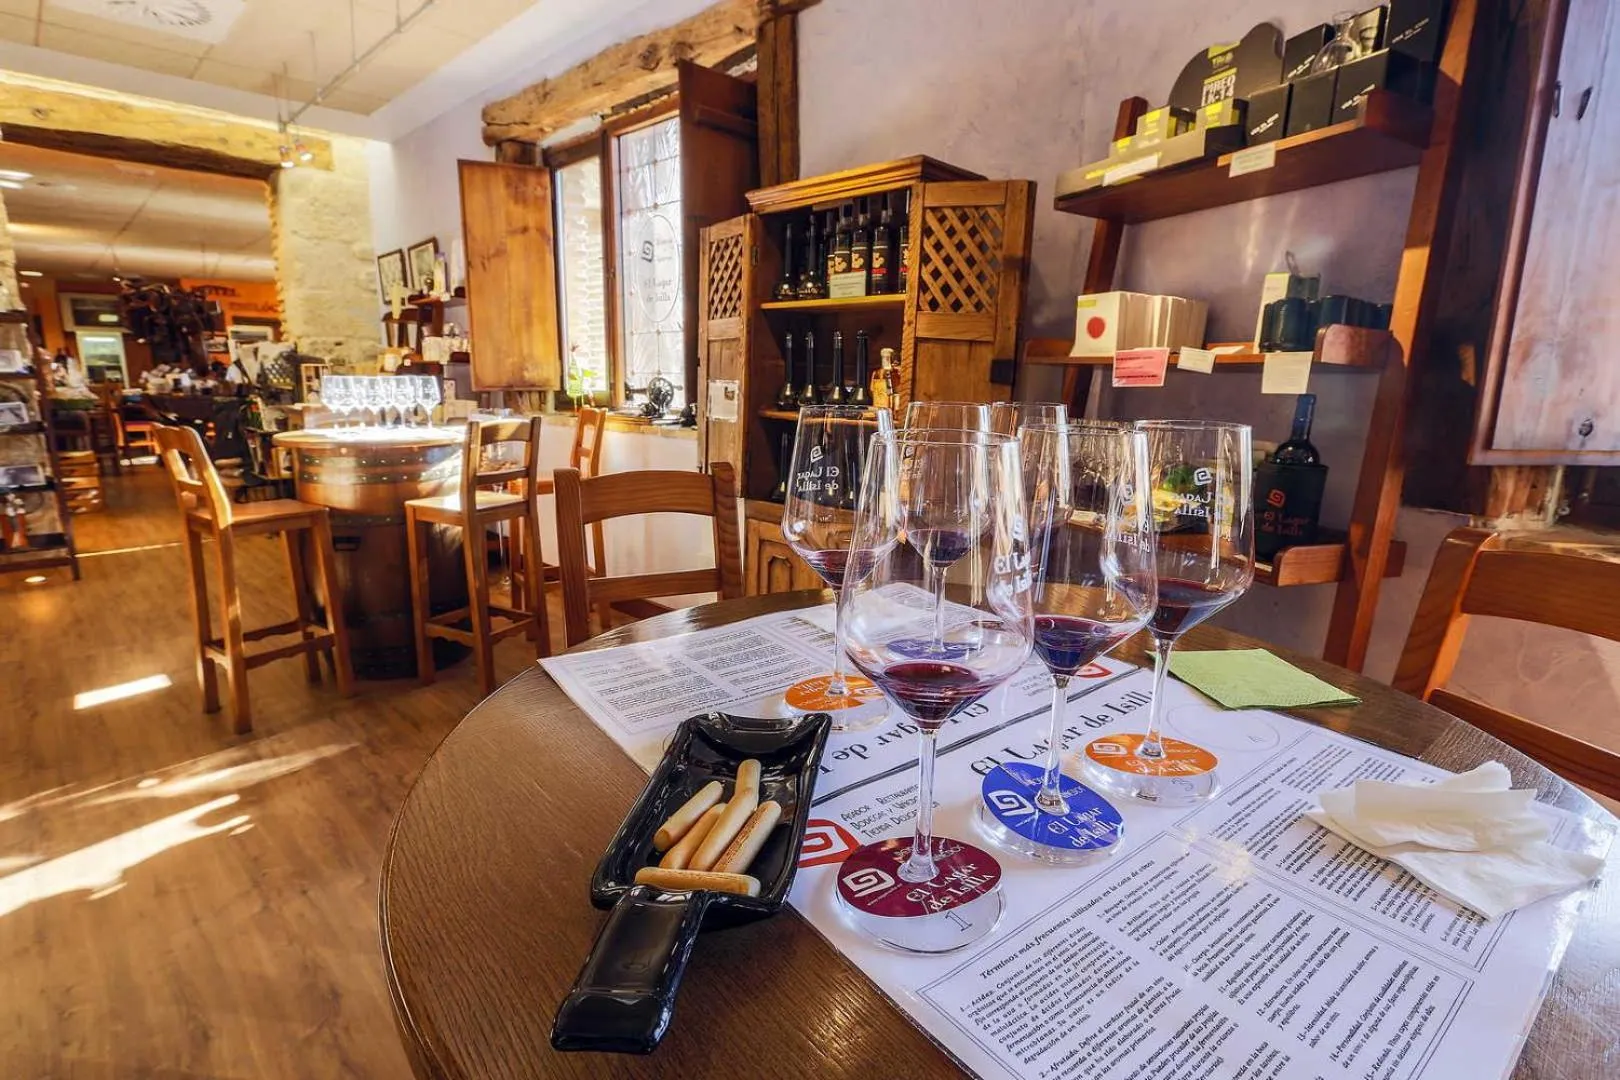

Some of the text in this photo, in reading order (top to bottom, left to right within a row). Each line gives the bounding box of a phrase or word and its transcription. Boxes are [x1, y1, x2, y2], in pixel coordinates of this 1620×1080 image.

[1080, 714, 1114, 731] de
[1103, 690, 1154, 717] Isill
[905, 886, 931, 902] El
[944, 909, 973, 932] 1
[979, 953, 1018, 978] Términos
[1018, 942, 1035, 954] más
[1034, 917, 1070, 945] frecuentes
